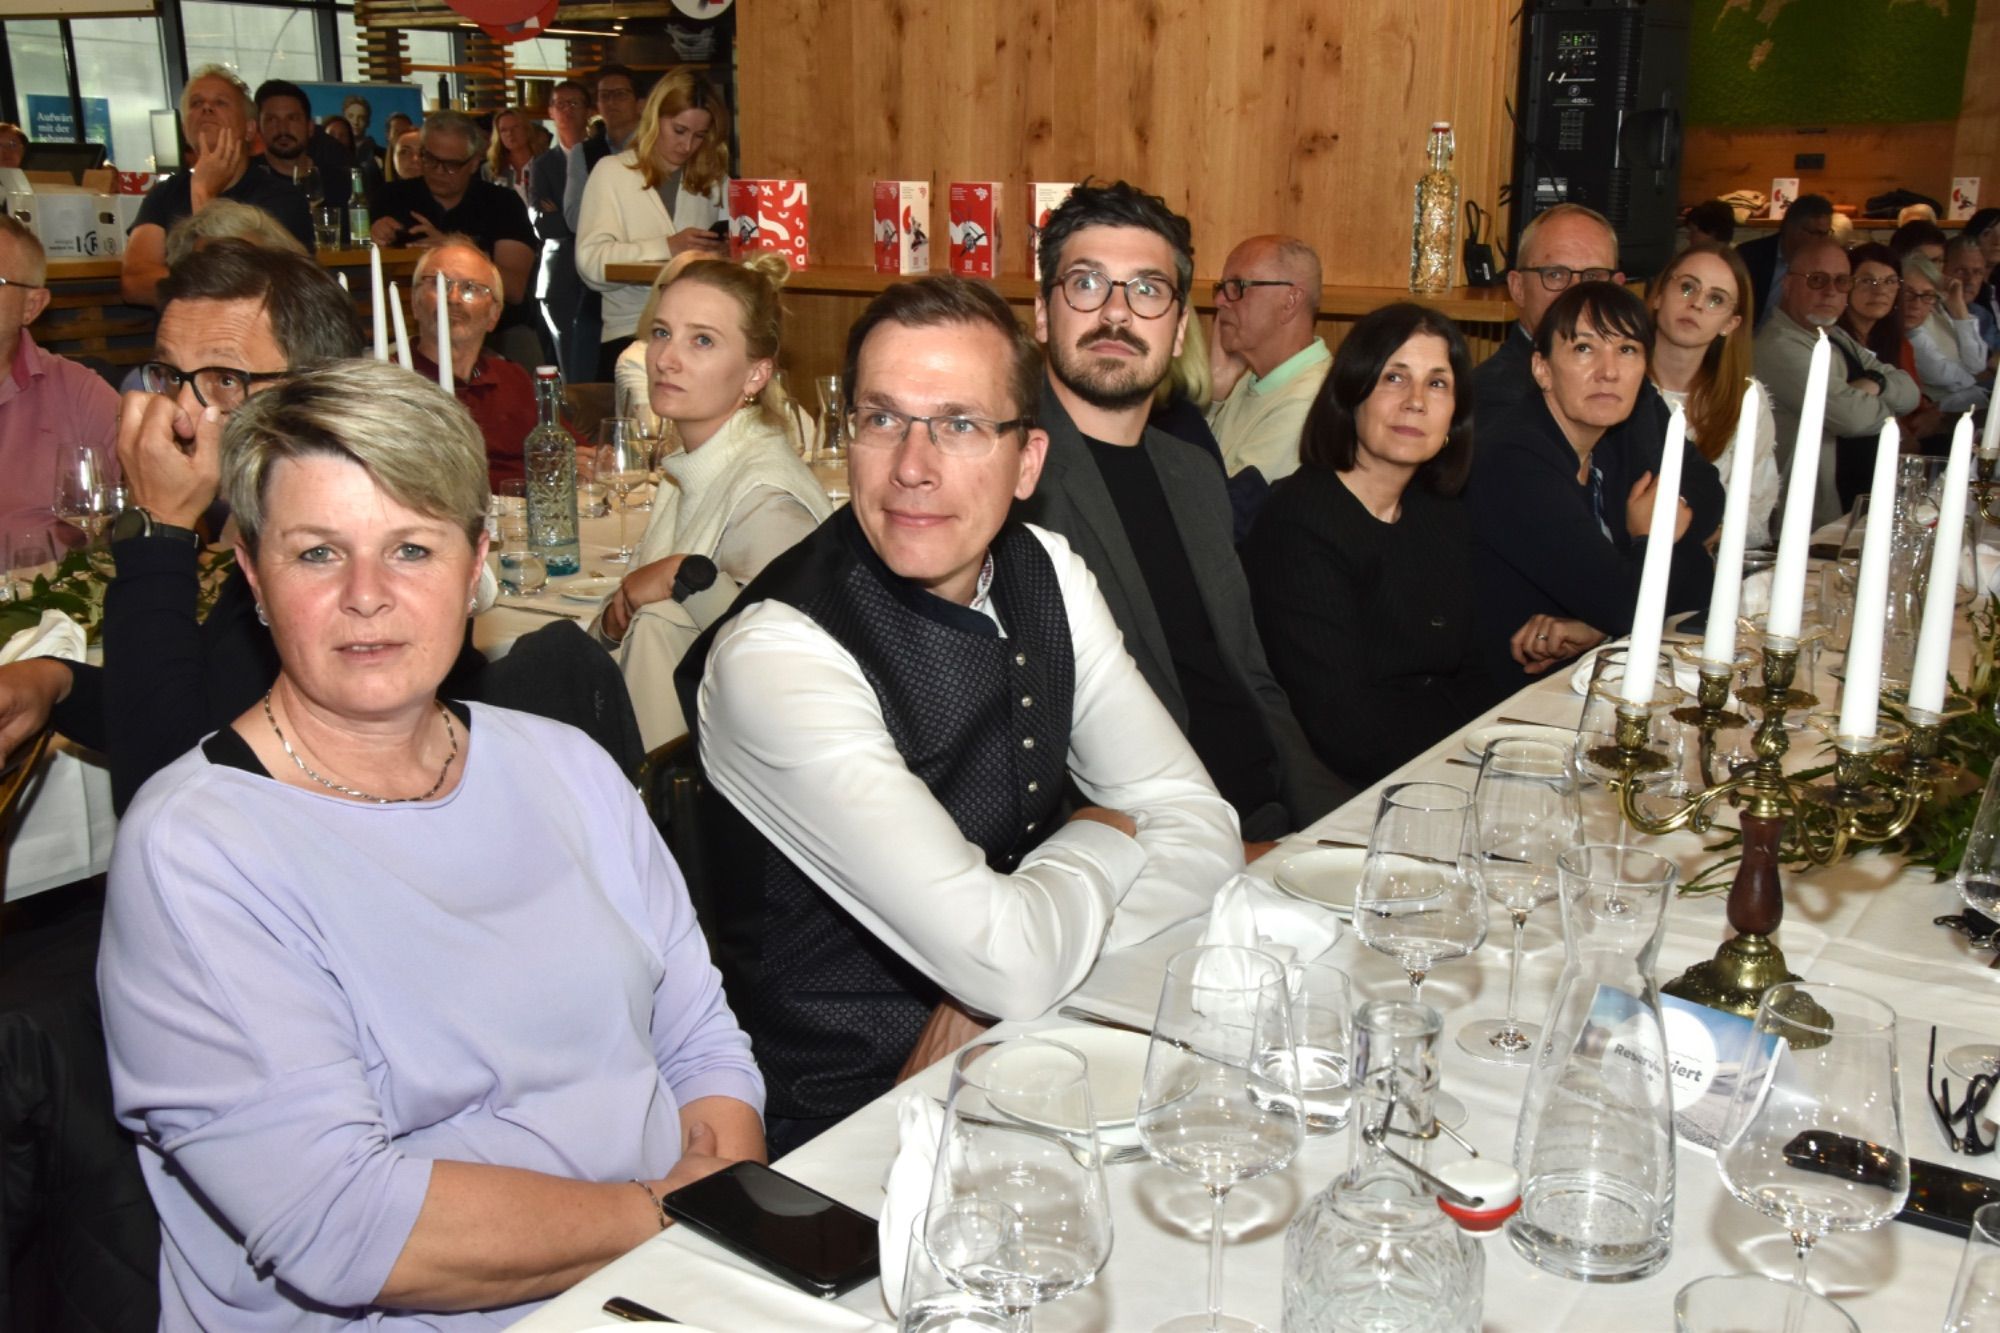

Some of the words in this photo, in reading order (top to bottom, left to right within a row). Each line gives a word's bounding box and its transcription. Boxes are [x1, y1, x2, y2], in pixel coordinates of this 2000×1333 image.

[37, 112, 74, 122] Aufwärt
[38, 124, 53, 132] mit
[55, 124, 70, 133] der
